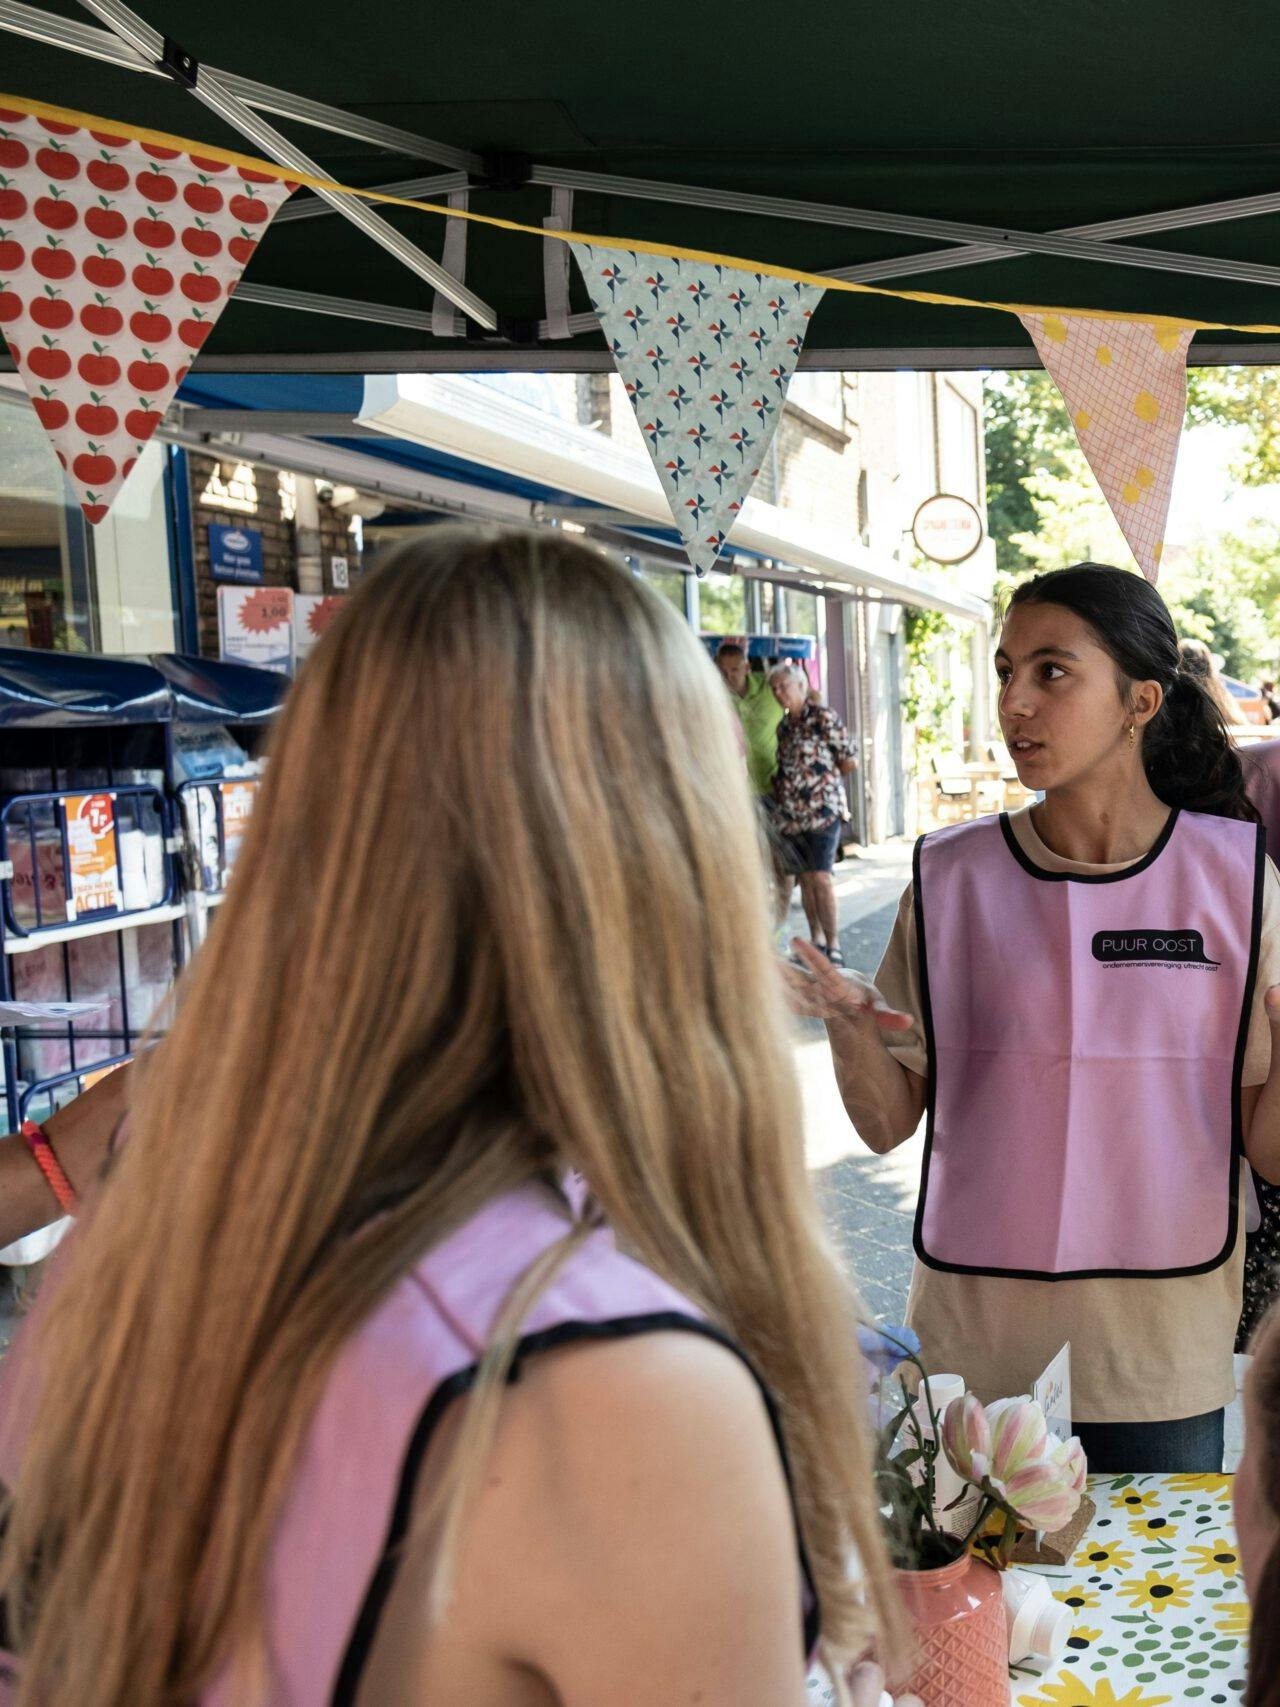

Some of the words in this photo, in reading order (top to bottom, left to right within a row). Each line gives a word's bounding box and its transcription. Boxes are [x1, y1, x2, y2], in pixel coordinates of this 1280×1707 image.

[76, 890, 115, 913] ACTIE
[1102, 938, 1148, 952] PUUR
[1152, 938, 1197, 952] OOST
[1102, 961, 1182, 970] ondernemersvereniging
